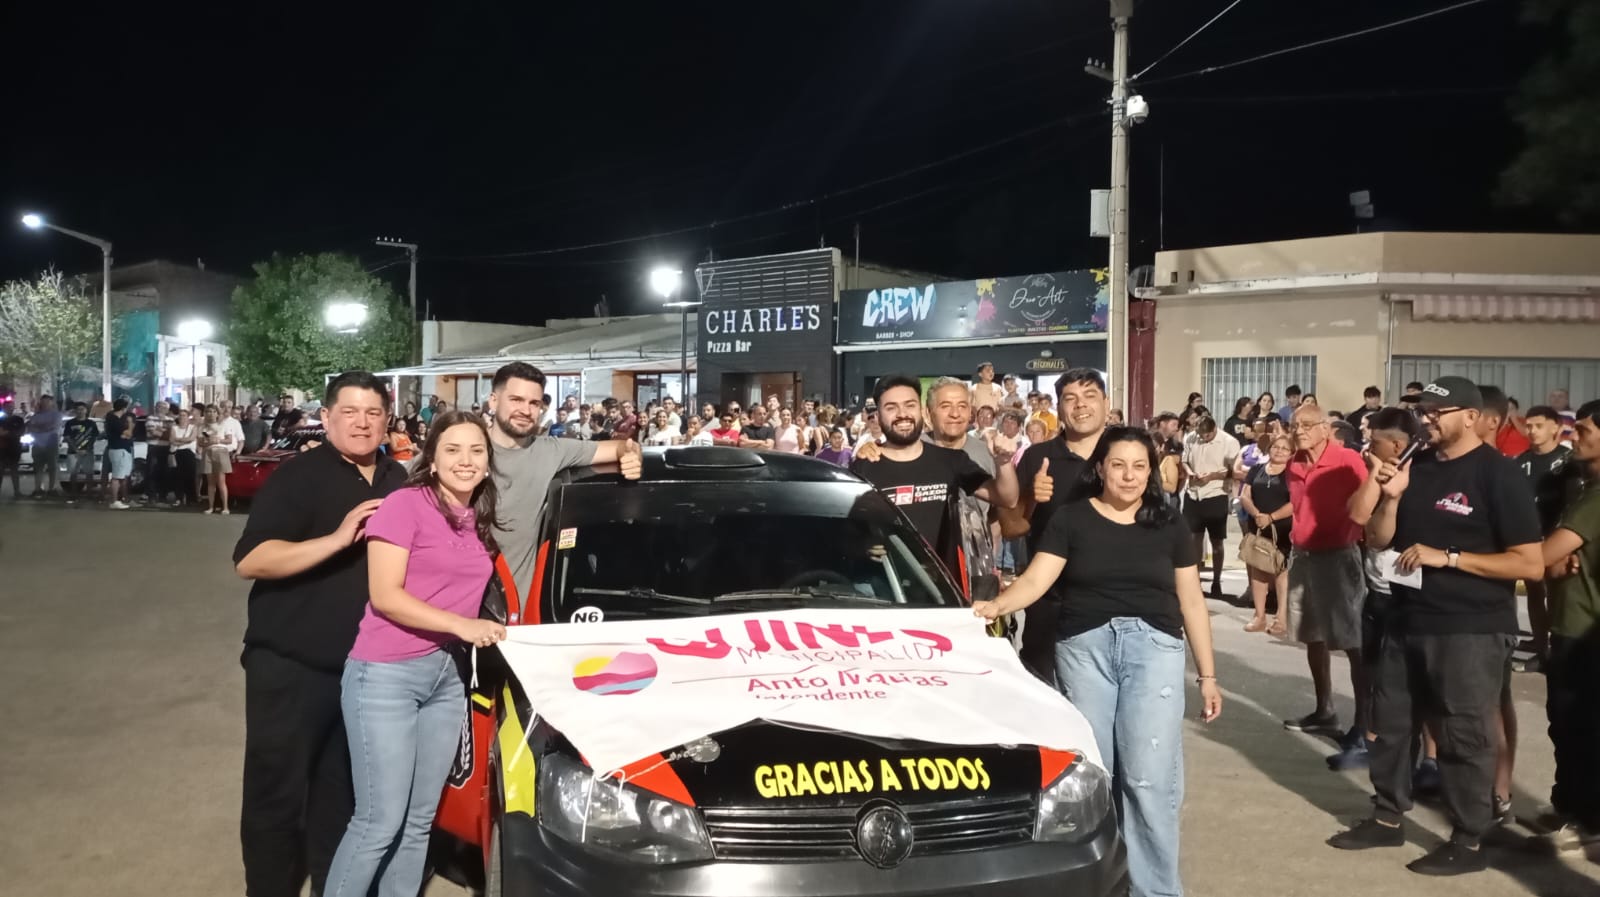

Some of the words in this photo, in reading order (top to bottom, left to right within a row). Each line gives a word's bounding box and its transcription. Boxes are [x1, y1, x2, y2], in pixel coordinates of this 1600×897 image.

[862, 283, 936, 328] CREW
[706, 304, 820, 334] CHARLE'S
[875, 332, 895, 340] BARBER
[707, 340, 732, 353] Pizza
[735, 340, 752, 353] Bar
[574, 611, 599, 623] N6
[748, 677, 828, 692] Anto
[755, 760, 874, 798] GRACIAS
[880, 759, 902, 791] A
[900, 757, 991, 791] TODOS
